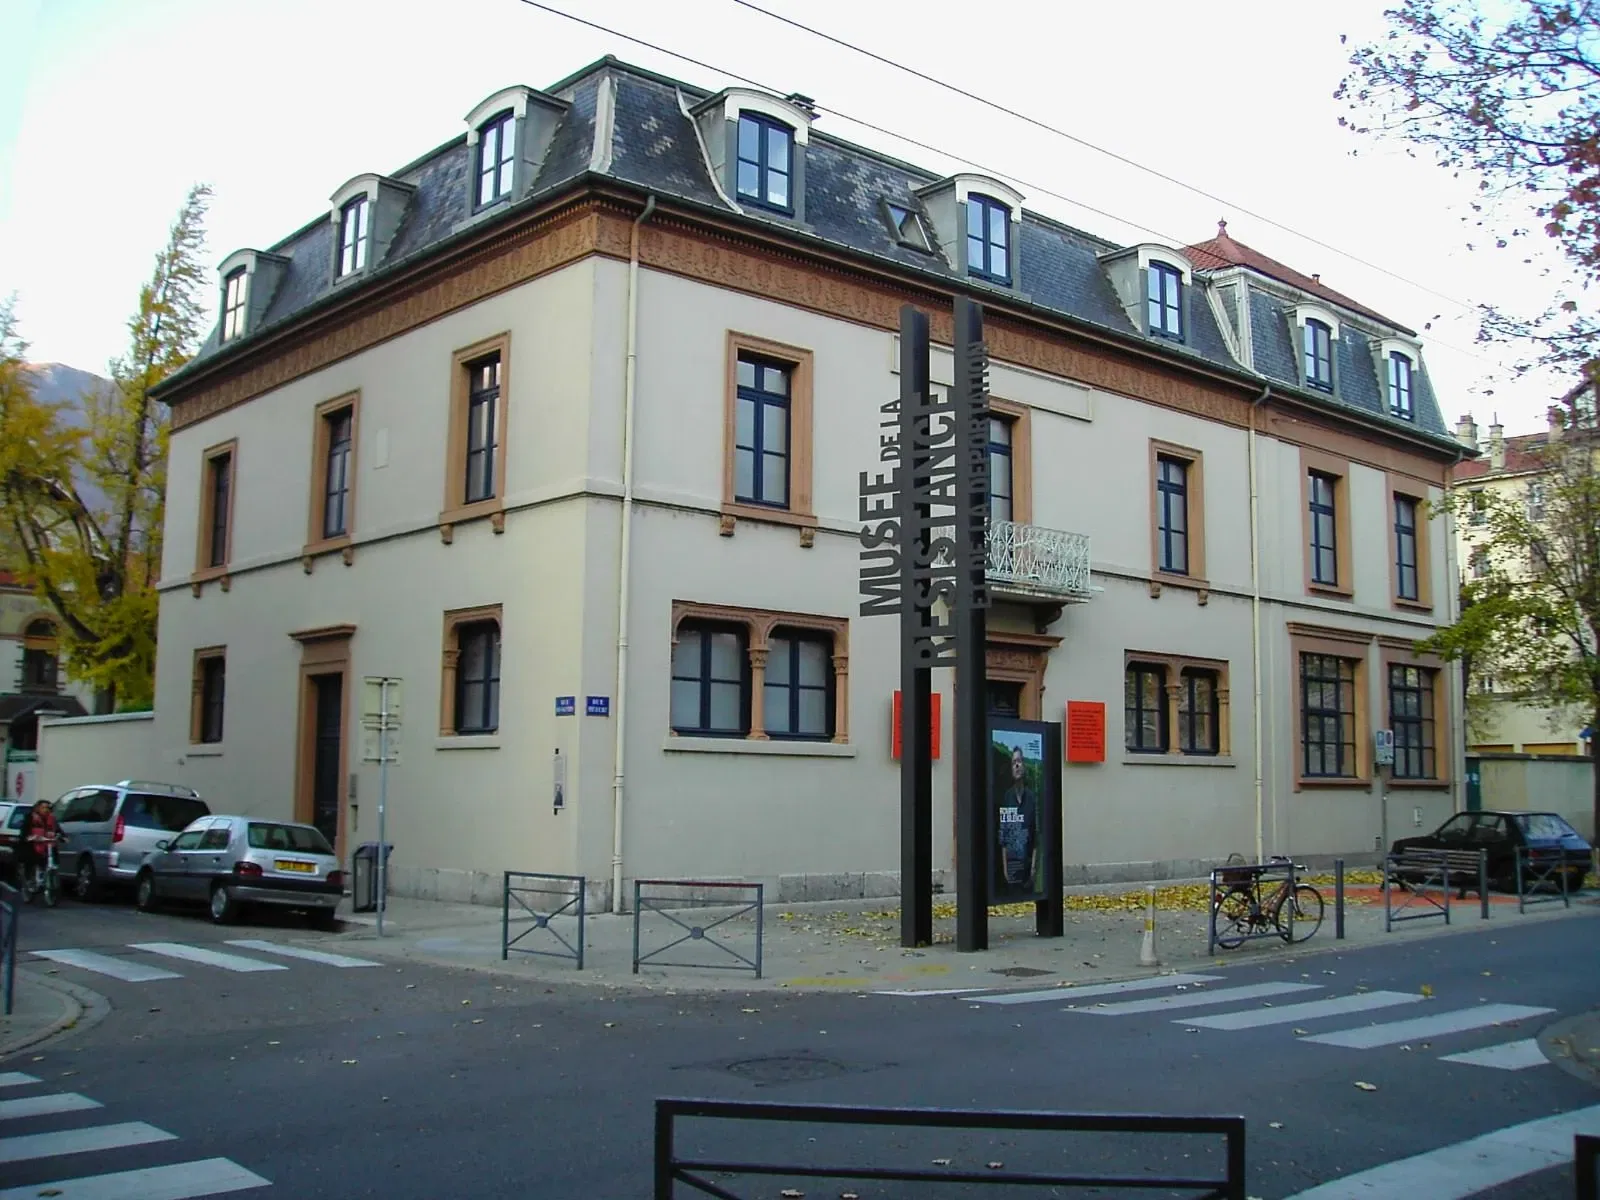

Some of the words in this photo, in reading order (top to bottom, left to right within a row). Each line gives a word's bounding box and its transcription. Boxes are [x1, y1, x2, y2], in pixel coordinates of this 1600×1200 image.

[880, 399, 902, 427] LA
[967, 341, 990, 494] DEPORTATION
[880, 433, 902, 462] DE
[913, 386, 957, 668] RESISTANCE
[967, 503, 990, 531] LA
[859, 467, 902, 617] MUSEE
[967, 541, 990, 571] DE
